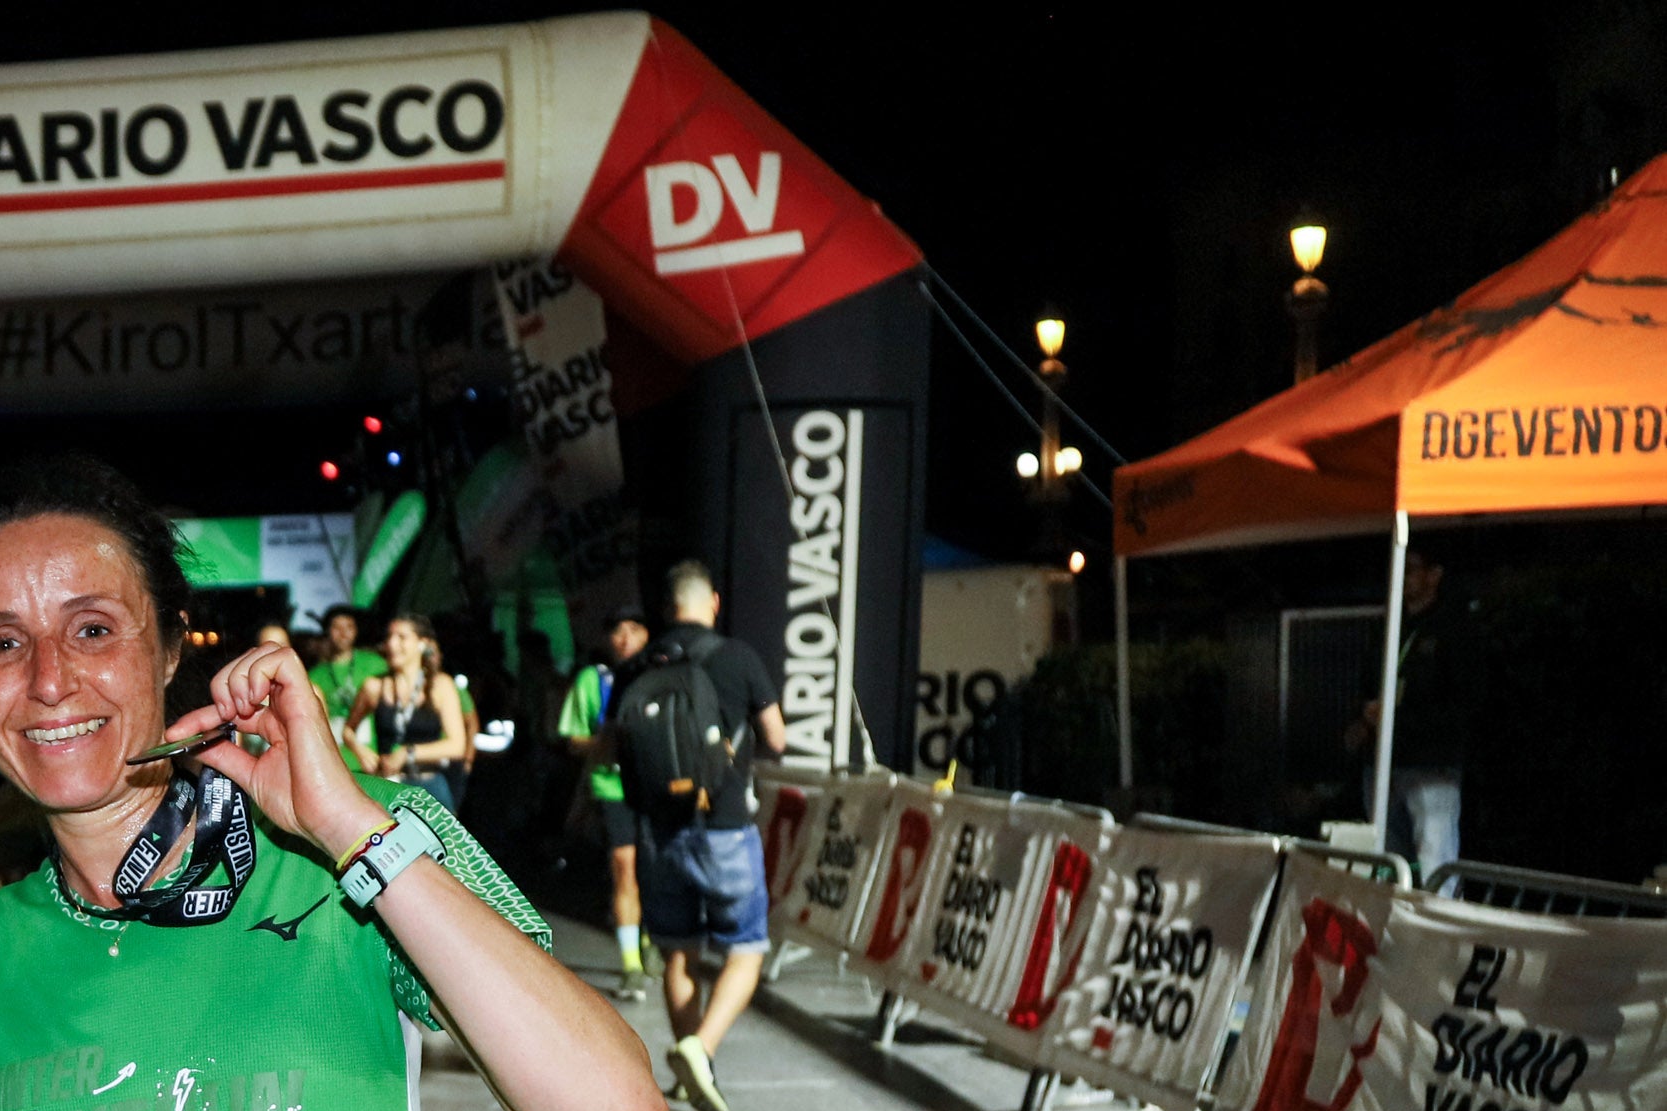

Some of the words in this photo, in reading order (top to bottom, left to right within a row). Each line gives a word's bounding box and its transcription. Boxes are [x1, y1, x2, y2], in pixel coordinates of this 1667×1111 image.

[205, 79, 505, 170] VASCO
[643, 151, 782, 249] DV
[1421, 403, 1667, 461] DGEVENTO
[786, 408, 847, 612] VASCO
[115, 837, 161, 895] FINIS
[1455, 944, 1507, 1010] EL
[1432, 1013, 1588, 1104] DIARIO
